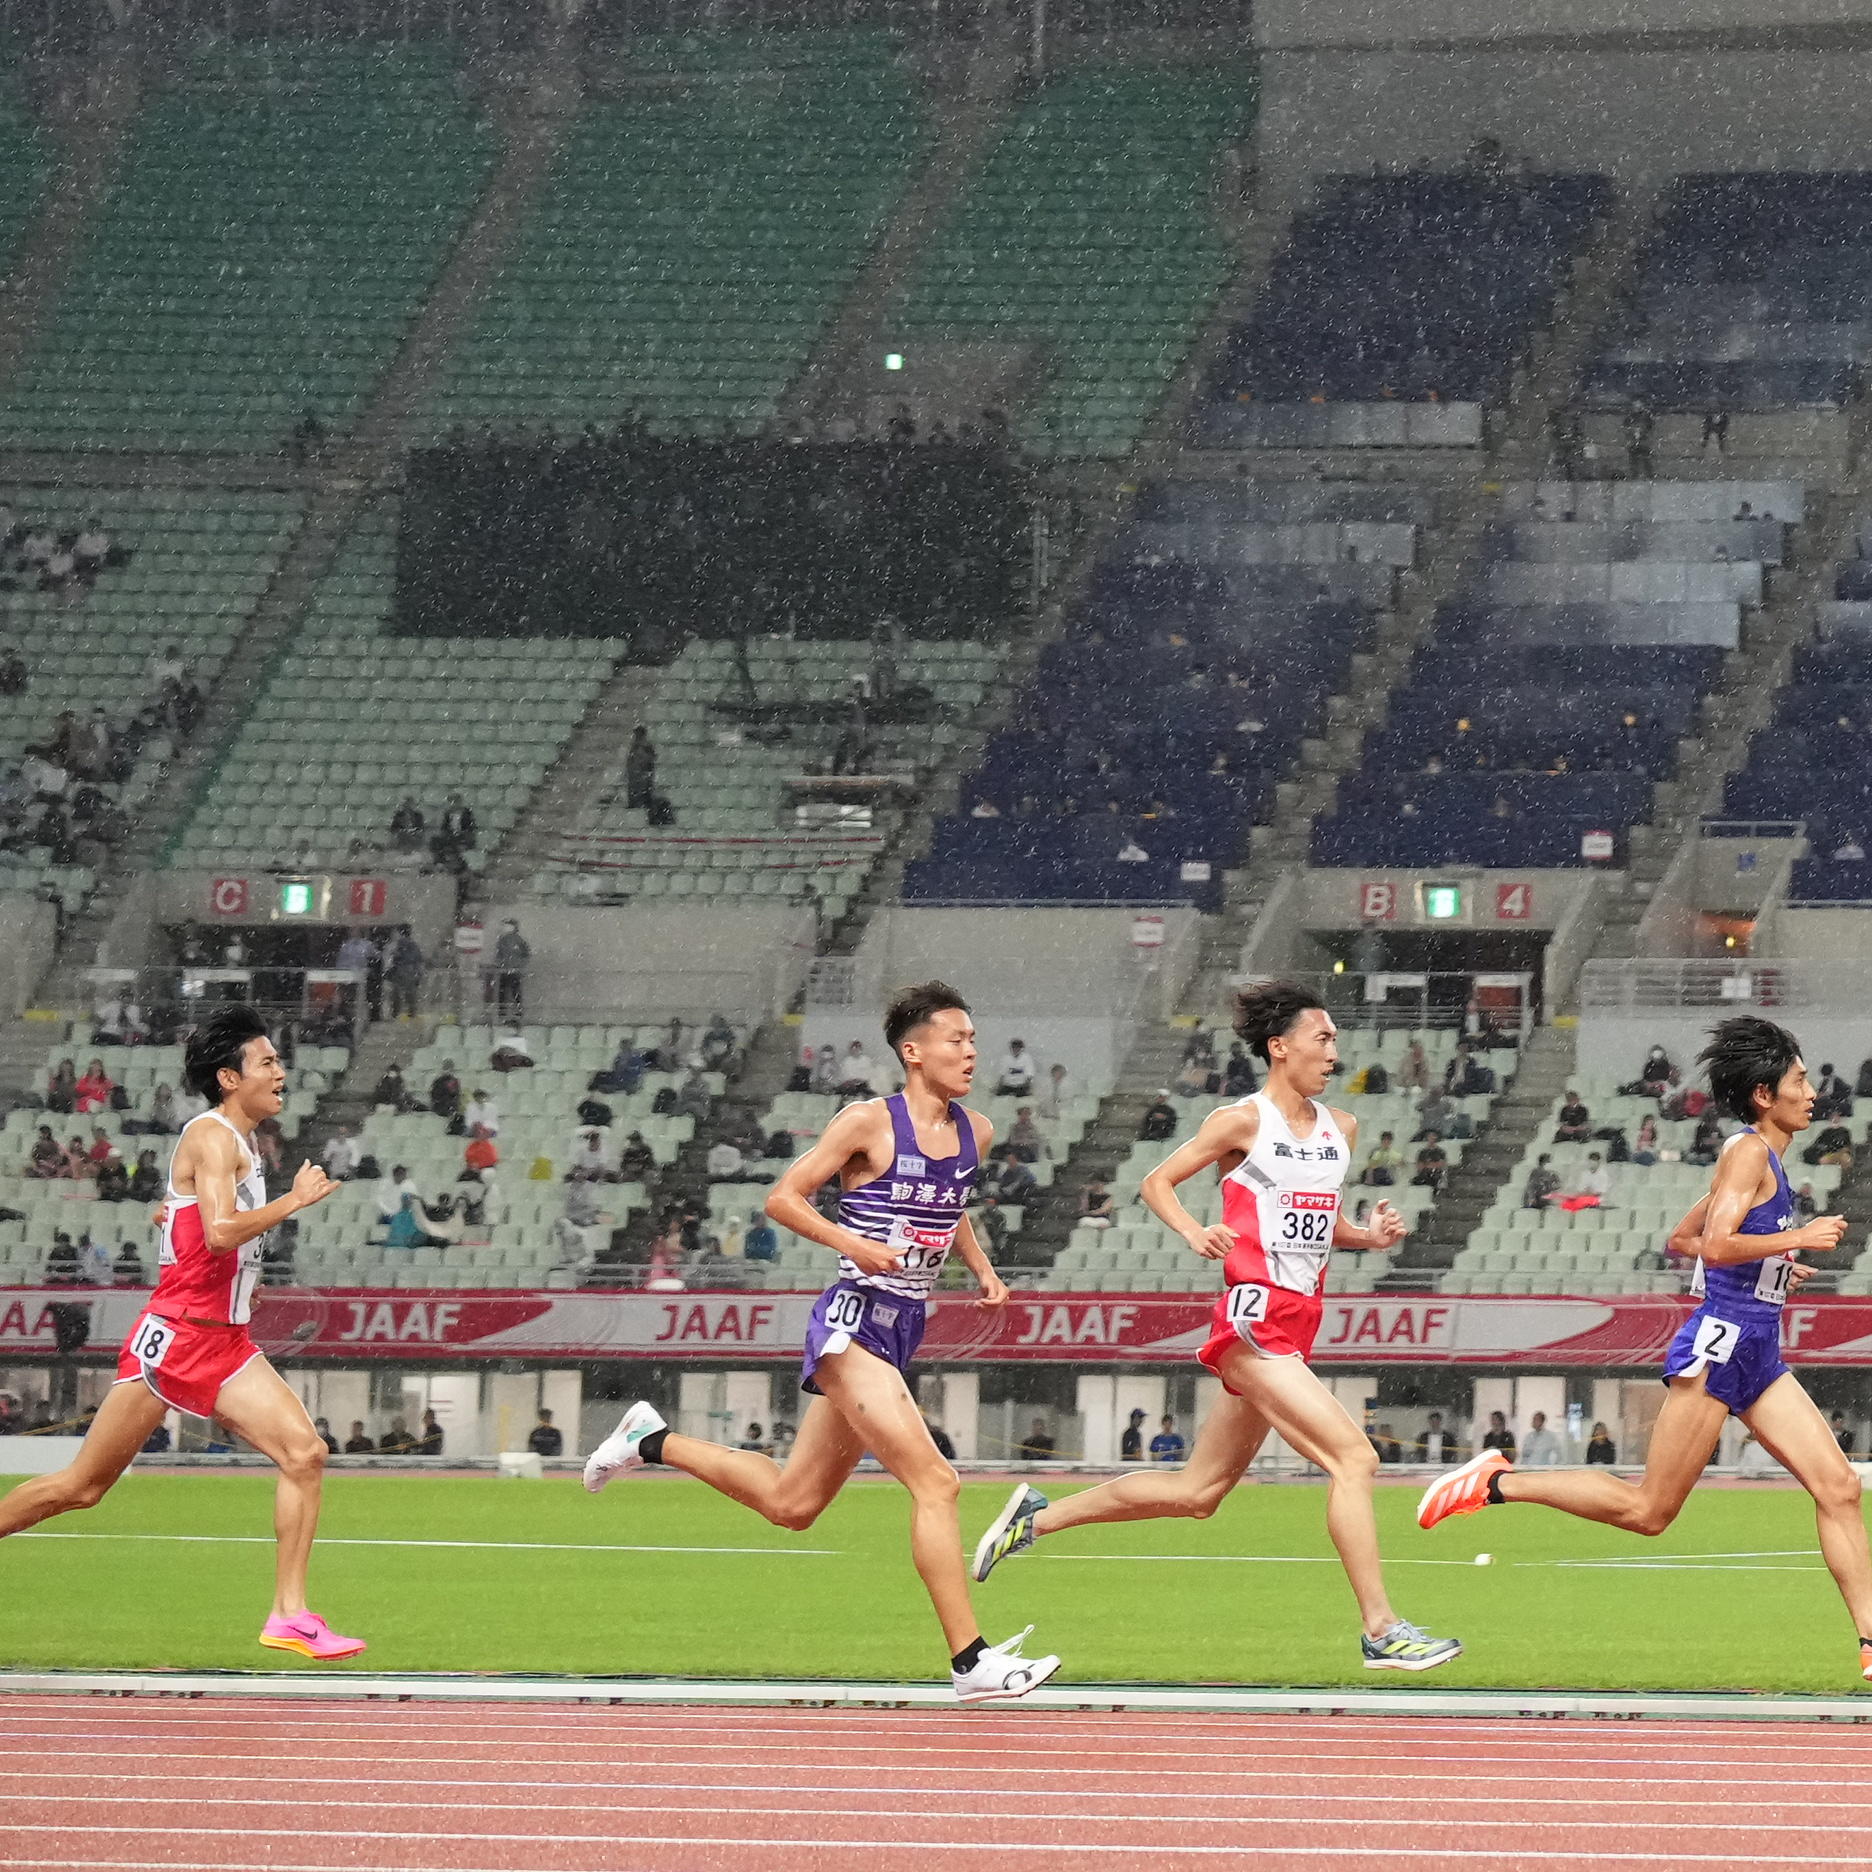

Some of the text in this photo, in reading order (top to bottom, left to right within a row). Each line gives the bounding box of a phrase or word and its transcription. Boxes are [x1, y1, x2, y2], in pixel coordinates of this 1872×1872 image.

[216, 881, 374, 912] C 1
[1364, 885, 1528, 916] B 4
[1273, 1142, 1340, 1161] 富士通
[1294, 1194, 1335, 1208] ヤマザキ
[1282, 1212, 1329, 1242] 382
[828, 1293, 863, 1327] 30
[1233, 1288, 1262, 1318] 12
[340, 1303, 463, 1341] JAAF
[655, 1304, 773, 1342] JAAF
[1017, 1305, 1138, 1344] JAAF
[1328, 1307, 1450, 1345] JAAF
[135, 1323, 164, 1359] 18
[1705, 1324, 1727, 1357] 2
